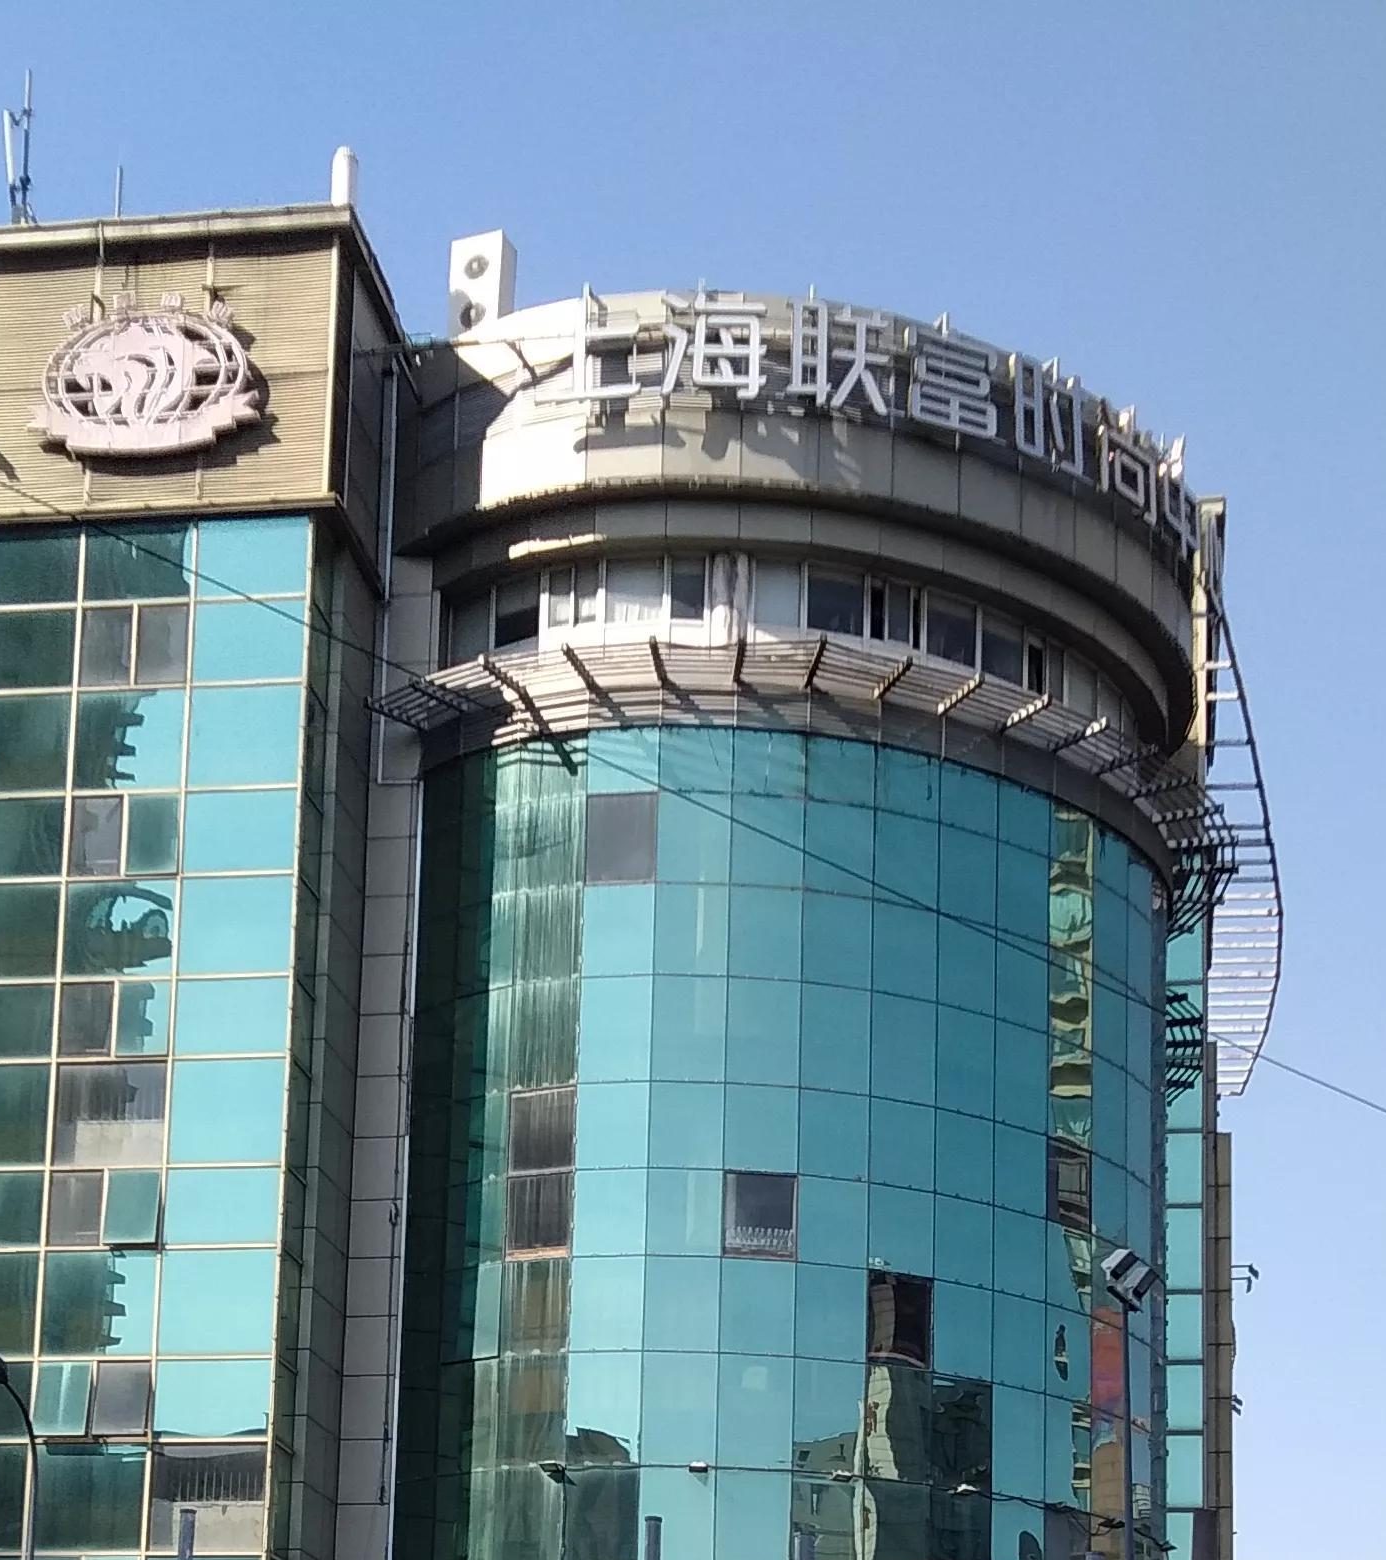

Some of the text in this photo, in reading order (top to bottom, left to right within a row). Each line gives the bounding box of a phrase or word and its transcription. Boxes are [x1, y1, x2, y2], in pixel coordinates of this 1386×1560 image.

[541, 280, 1225, 612] 上海联富时尚中
